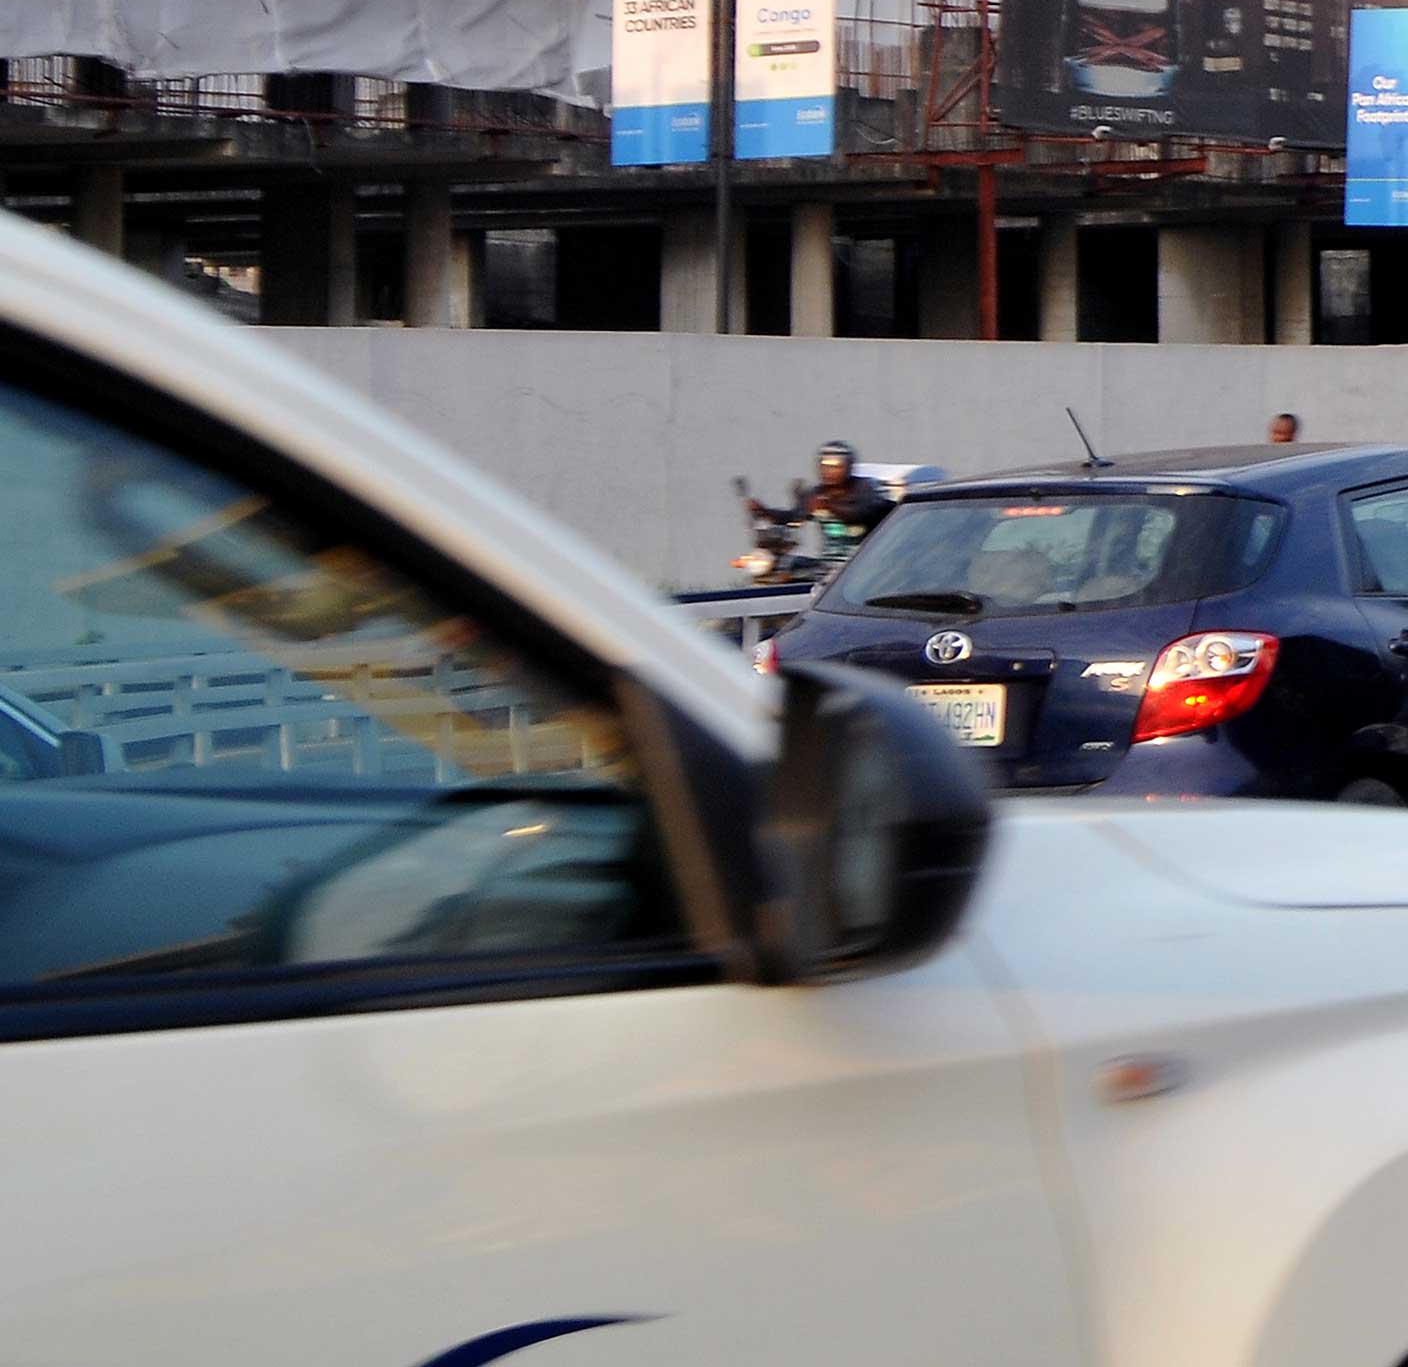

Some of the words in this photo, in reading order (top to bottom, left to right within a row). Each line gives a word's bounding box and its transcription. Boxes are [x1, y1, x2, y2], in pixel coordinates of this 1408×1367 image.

[624, 1, 638, 14] 33
[757, 8, 811, 25] Congo
[625, 16, 696, 32] COUNTRIES
[1372, 76, 1398, 89] Our
[1352, 93, 1374, 106] Pan
[1070, 105, 1174, 124] #BLUESWIFTNG
[1111, 677, 1129, 691] S
